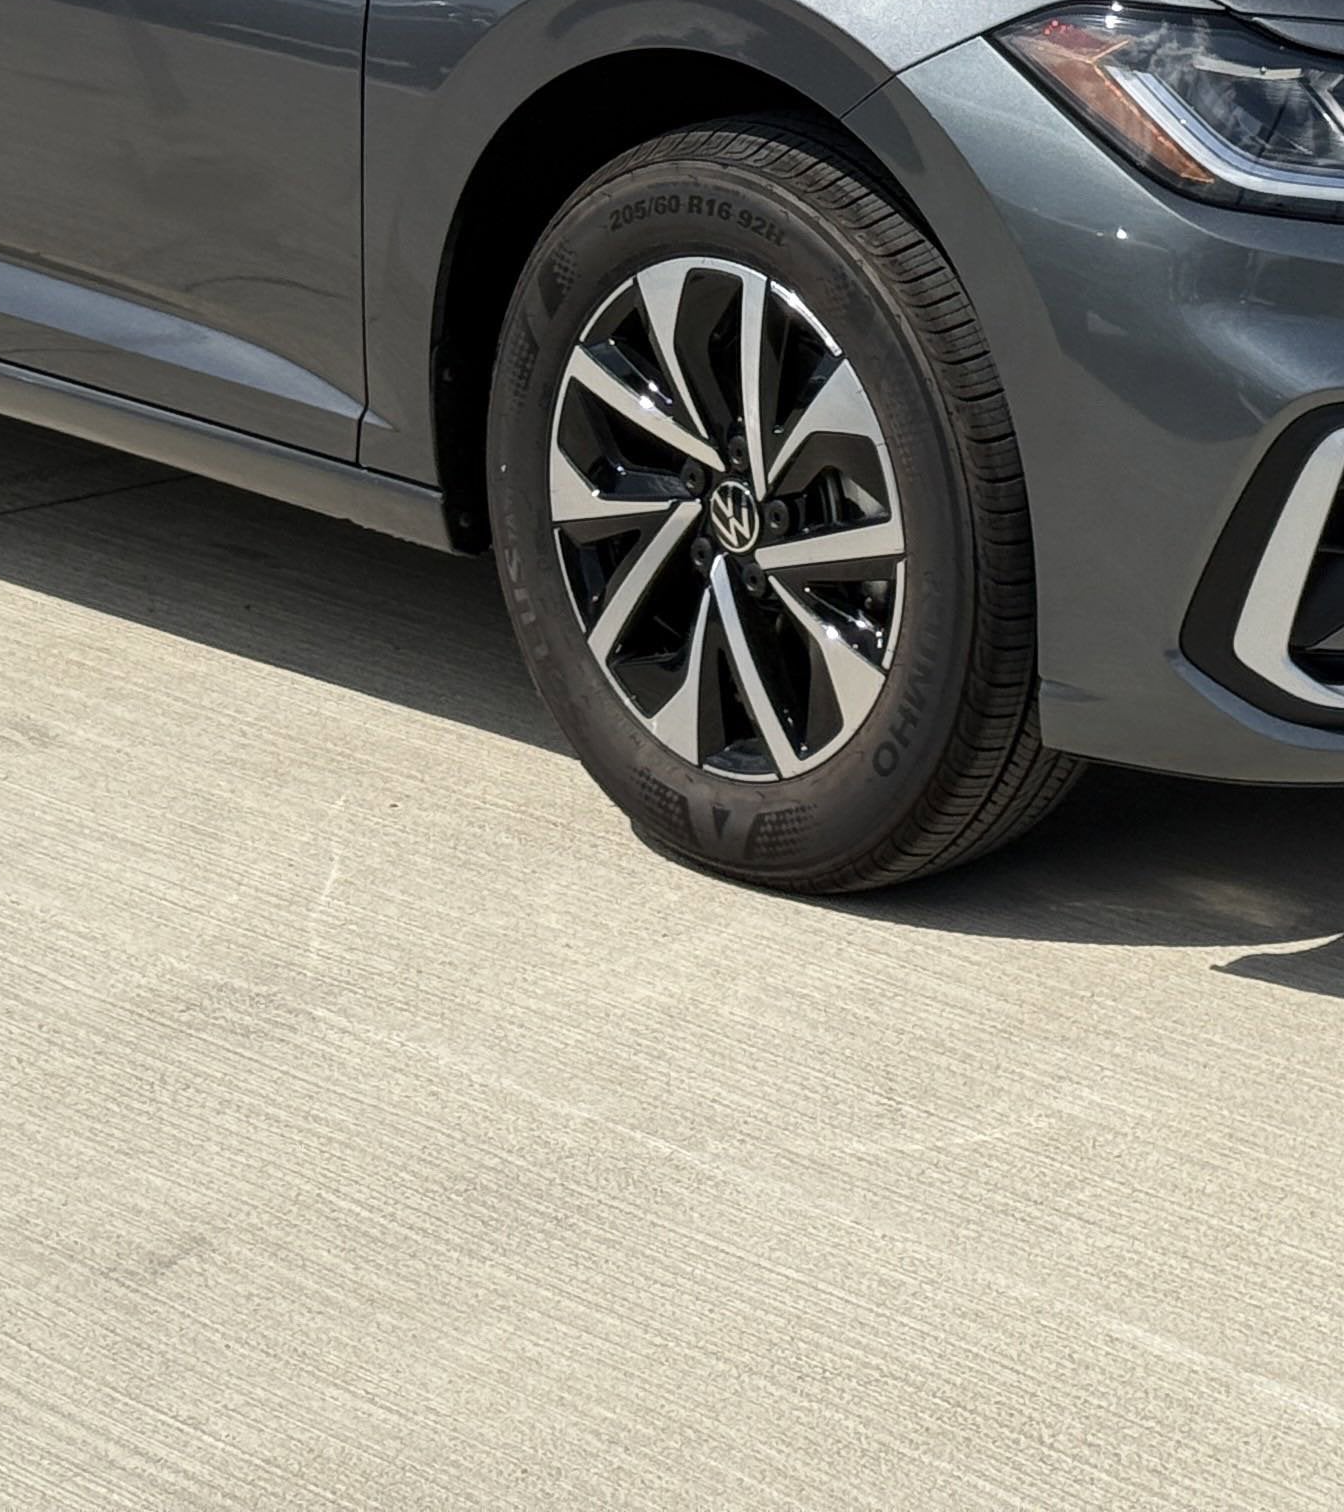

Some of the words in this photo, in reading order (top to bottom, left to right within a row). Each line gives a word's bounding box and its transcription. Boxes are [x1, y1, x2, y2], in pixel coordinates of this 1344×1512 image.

[608, 194, 680, 232] 205/60
[687, 194, 733, 221] R16
[737, 209, 785, 247] 92H
[711, 481, 759, 552] VW
